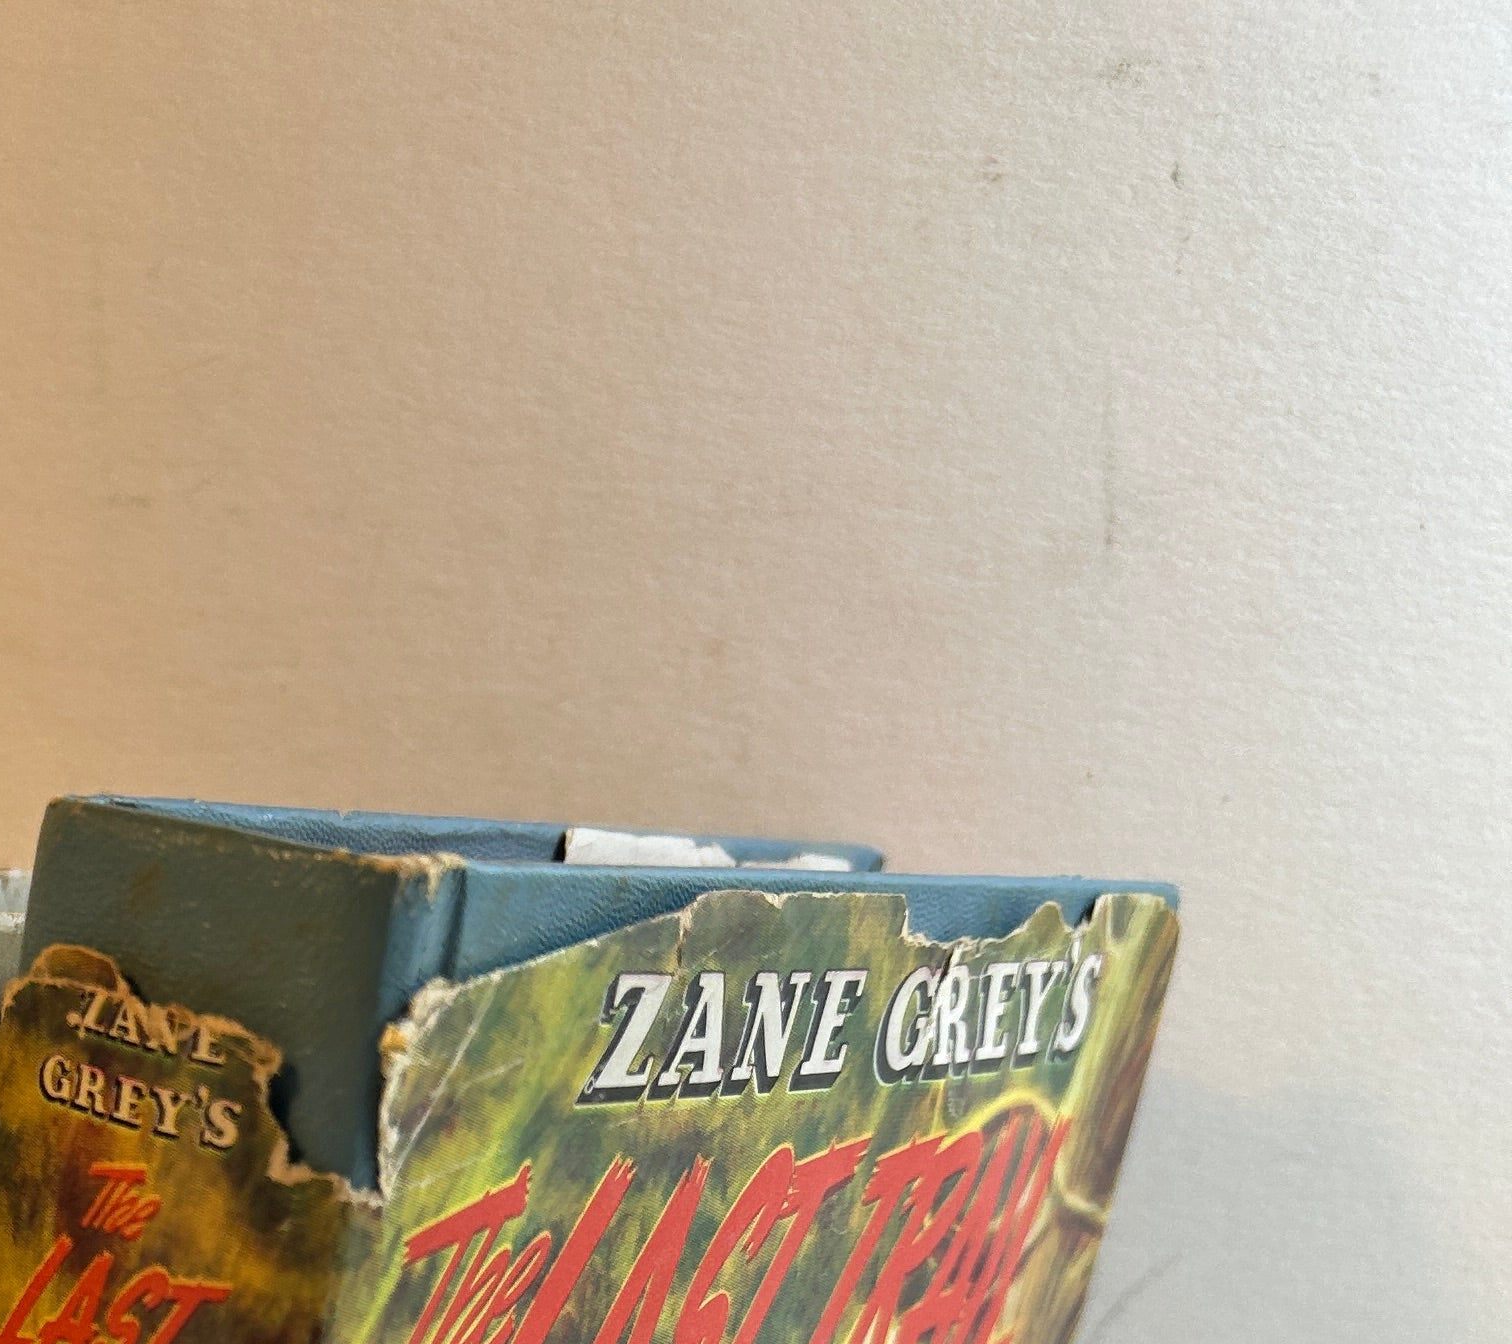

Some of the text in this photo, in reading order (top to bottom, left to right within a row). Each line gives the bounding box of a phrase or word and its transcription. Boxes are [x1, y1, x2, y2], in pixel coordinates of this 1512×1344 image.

[576, 951, 1102, 1107] ZANE GREY'S
[41, 1054, 245, 1152] GREY'S
